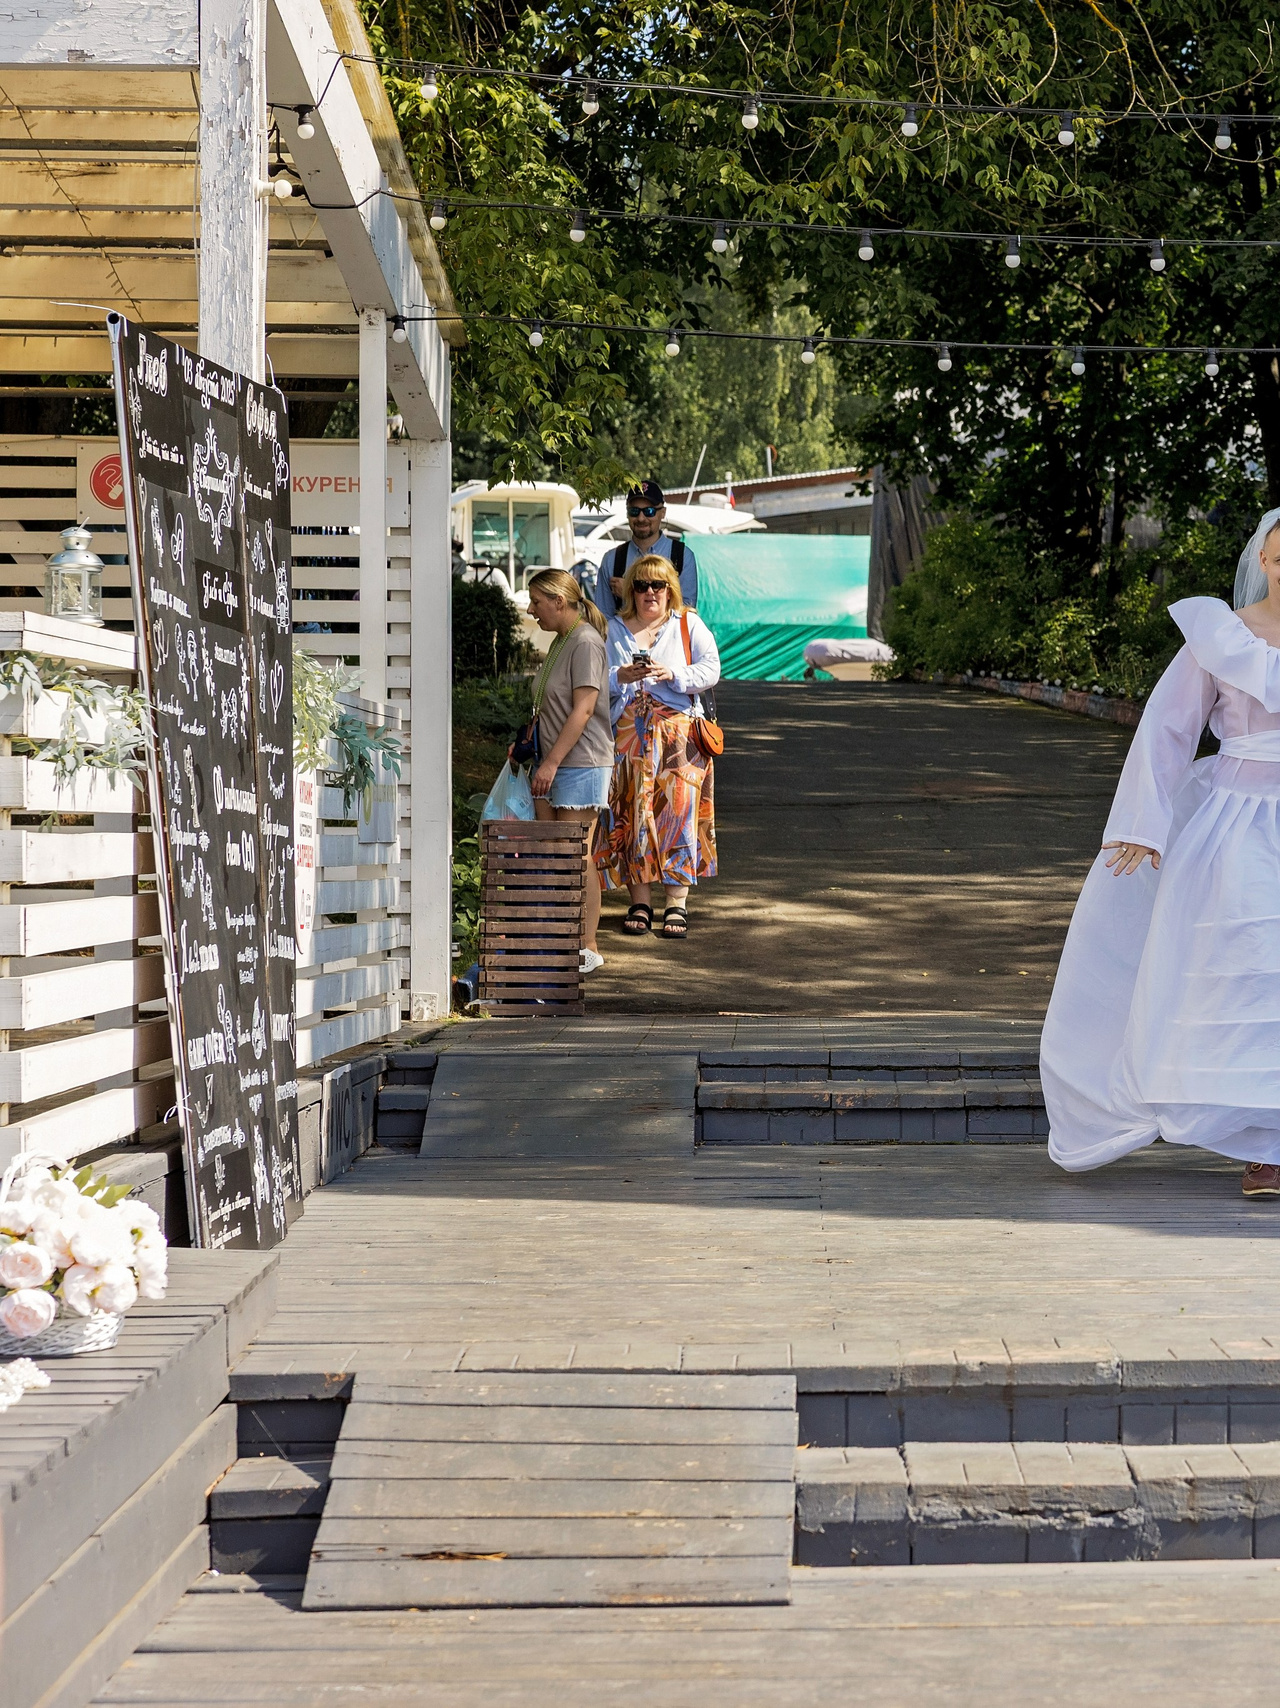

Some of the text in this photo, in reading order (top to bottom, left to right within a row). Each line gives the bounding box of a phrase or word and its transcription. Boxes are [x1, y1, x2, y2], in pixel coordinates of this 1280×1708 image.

[187, 1036, 206, 1071] GAME
[205, 1028, 226, 1065] OVER
[336, 1088, 351, 1153] WC
